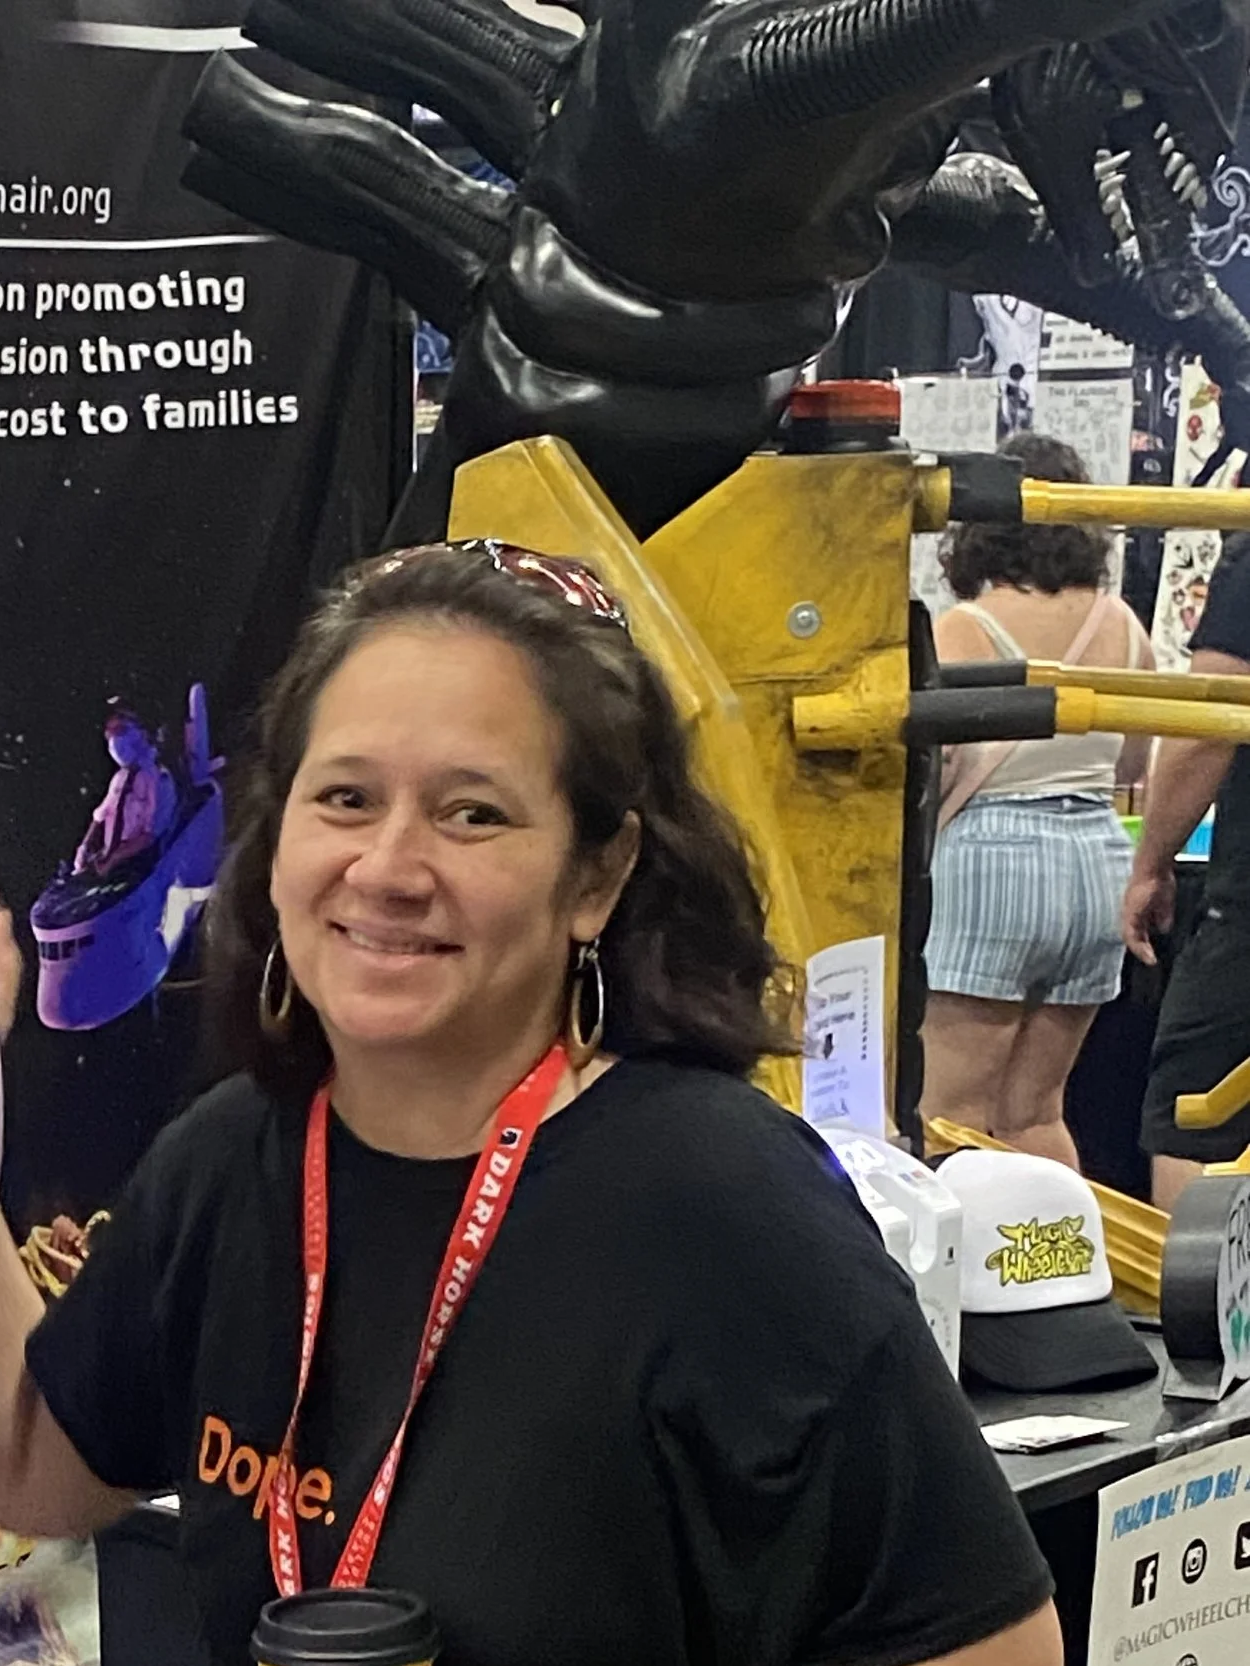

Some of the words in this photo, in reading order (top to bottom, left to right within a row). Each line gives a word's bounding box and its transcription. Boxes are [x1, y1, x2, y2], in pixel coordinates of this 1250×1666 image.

[35, 270, 246, 320] promoting
[78, 328, 253, 375] through
[78, 400, 129, 435] to
[142, 388, 300, 430] families
[461, 1150, 513, 1249] DARK
